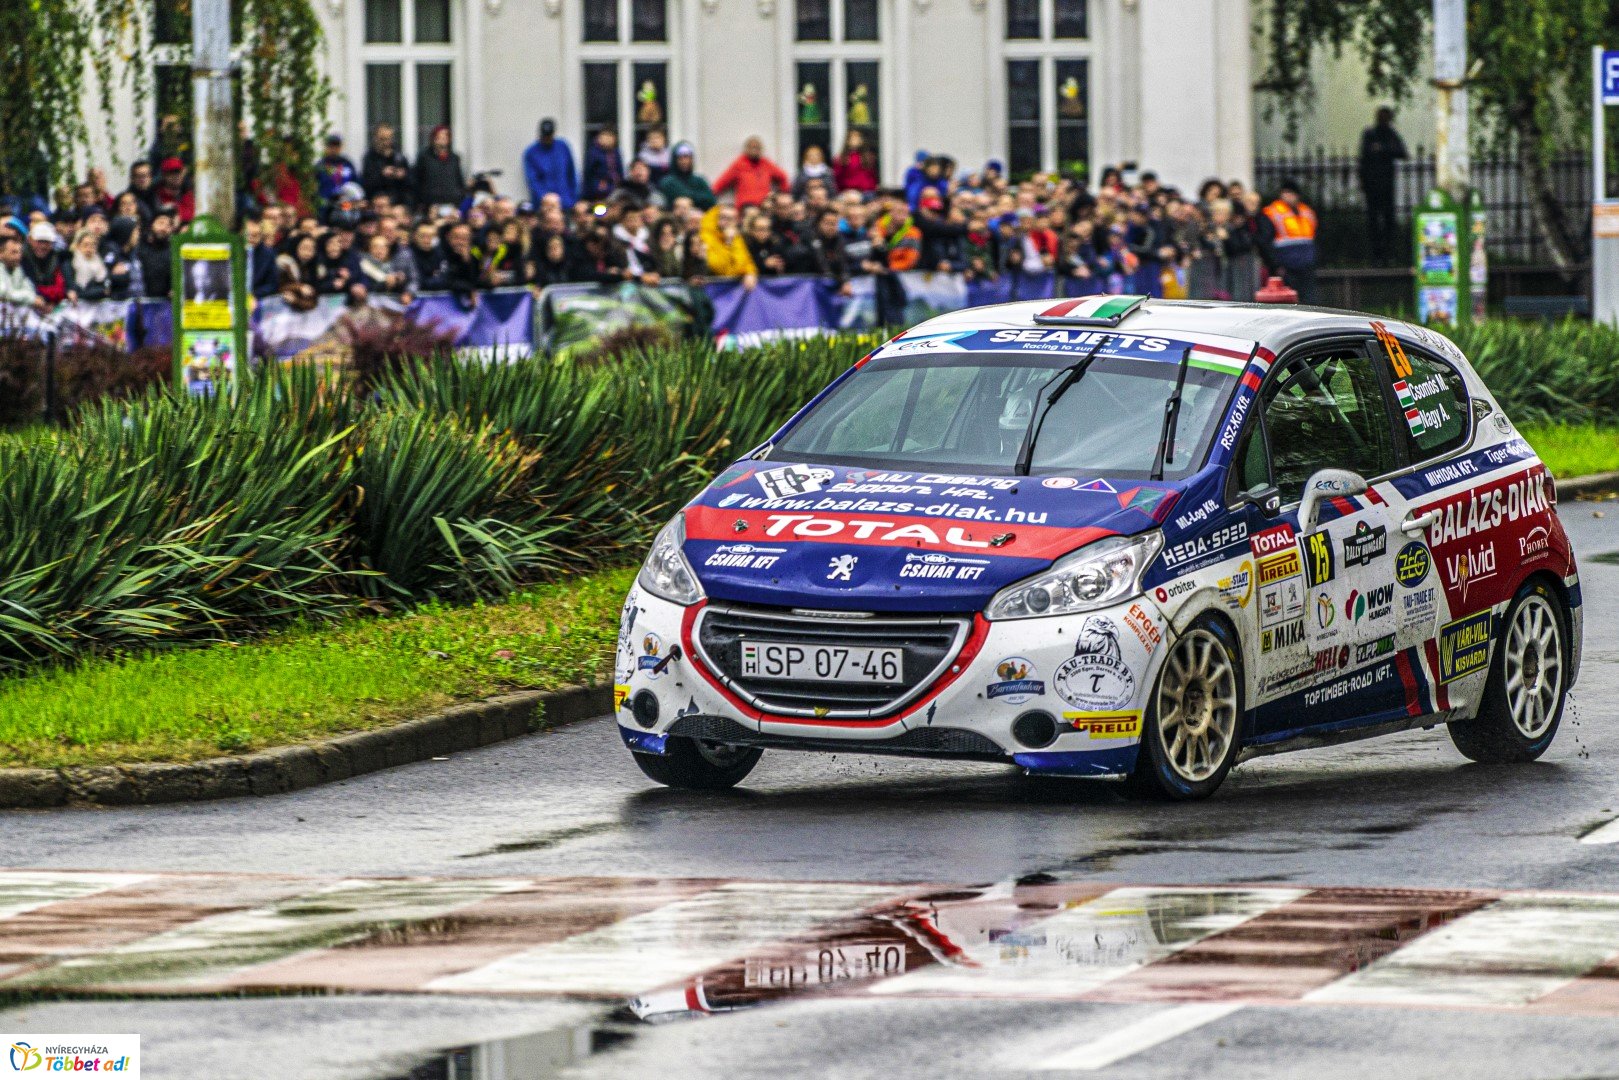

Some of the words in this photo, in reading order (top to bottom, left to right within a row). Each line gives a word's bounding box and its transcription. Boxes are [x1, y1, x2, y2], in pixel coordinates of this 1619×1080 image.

[990, 329, 1170, 352] SEAJETS
[1023, 343, 1058, 351] Racing
[1436, 373, 1449, 391] M.
[1419, 409, 1442, 429] Nagy
[1438, 403, 1450, 421] A.
[1425, 463, 1461, 487] MIHIDRA
[1459, 458, 1478, 477] KFT.
[740, 497, 1048, 524] www.balazs-diak.hu
[1175, 509, 1208, 530] ML-Log
[1430, 469, 1550, 547] BALÁZS-DIÁK
[765, 515, 989, 548] TOTAL
[1250, 530, 1295, 553] TOTAL
[704, 554, 755, 568] CSAVAR
[751, 556, 780, 569] KFT
[899, 563, 952, 578] CSAVAR
[955, 566, 985, 580] KFT
[1259, 552, 1299, 582] PIRELLI
[1309, 532, 1329, 584] 25
[1168, 580, 1197, 597] orbitex
[1367, 583, 1394, 611] WOW
[1129, 604, 1161, 644] ÉPGÉP
[1274, 619, 1305, 650] MIKA
[745, 661, 756, 674] H
[765, 646, 804, 676] SP
[815, 649, 898, 680] 07-46
[1057, 655, 1121, 682] TAU-TRADE
[1304, 673, 1373, 708] TOPTIMBER-ROAD
[1375, 664, 1393, 683] KFT.
